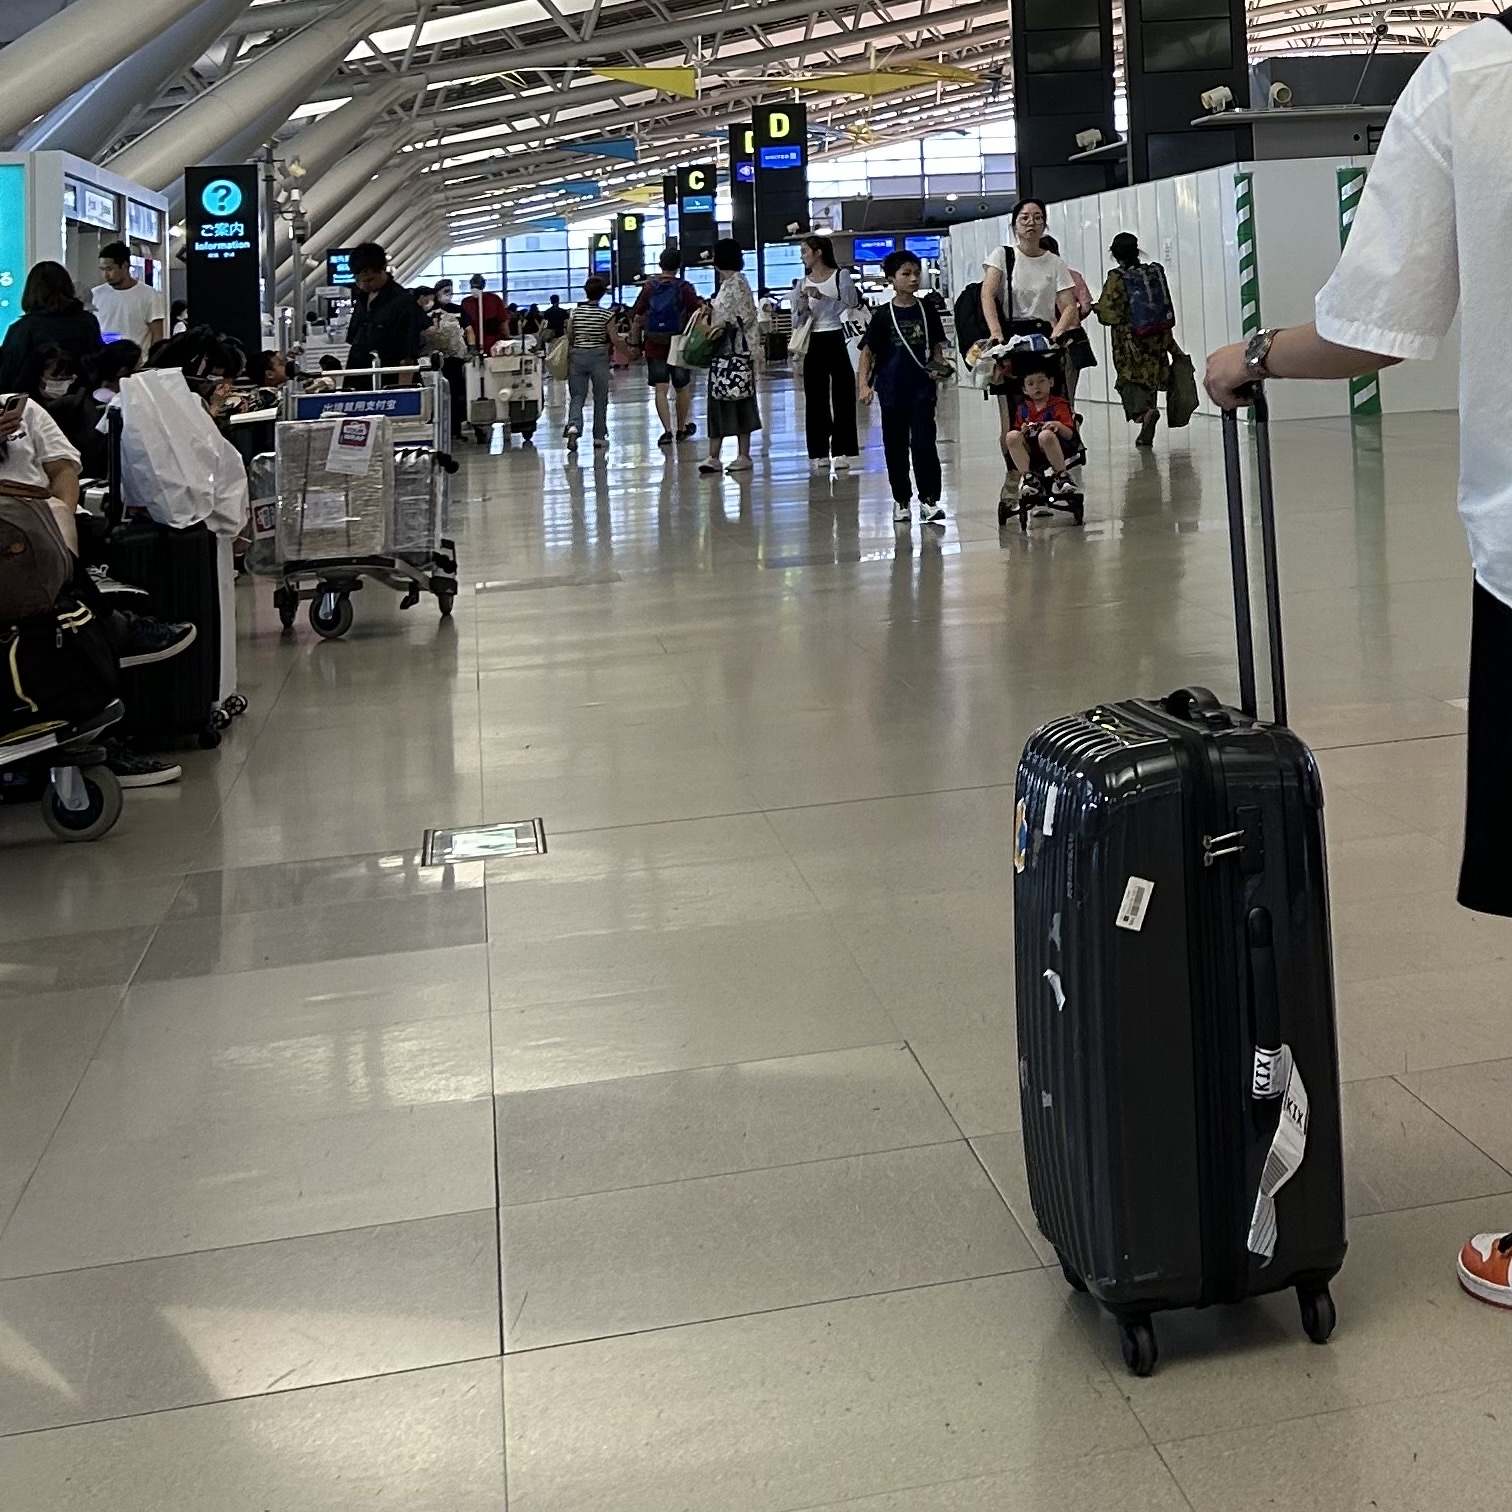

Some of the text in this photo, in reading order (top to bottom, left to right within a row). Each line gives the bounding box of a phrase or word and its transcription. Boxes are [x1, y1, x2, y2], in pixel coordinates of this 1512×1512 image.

[769, 113, 790, 138] D
[688, 171, 705, 190] C
[201, 221, 244, 237] ご案内
[624, 216, 637, 231] B
[598, 235, 610, 248] A
[1255, 1057, 1271, 1092] KIX
[1286, 1096, 1304, 1129] KIX
